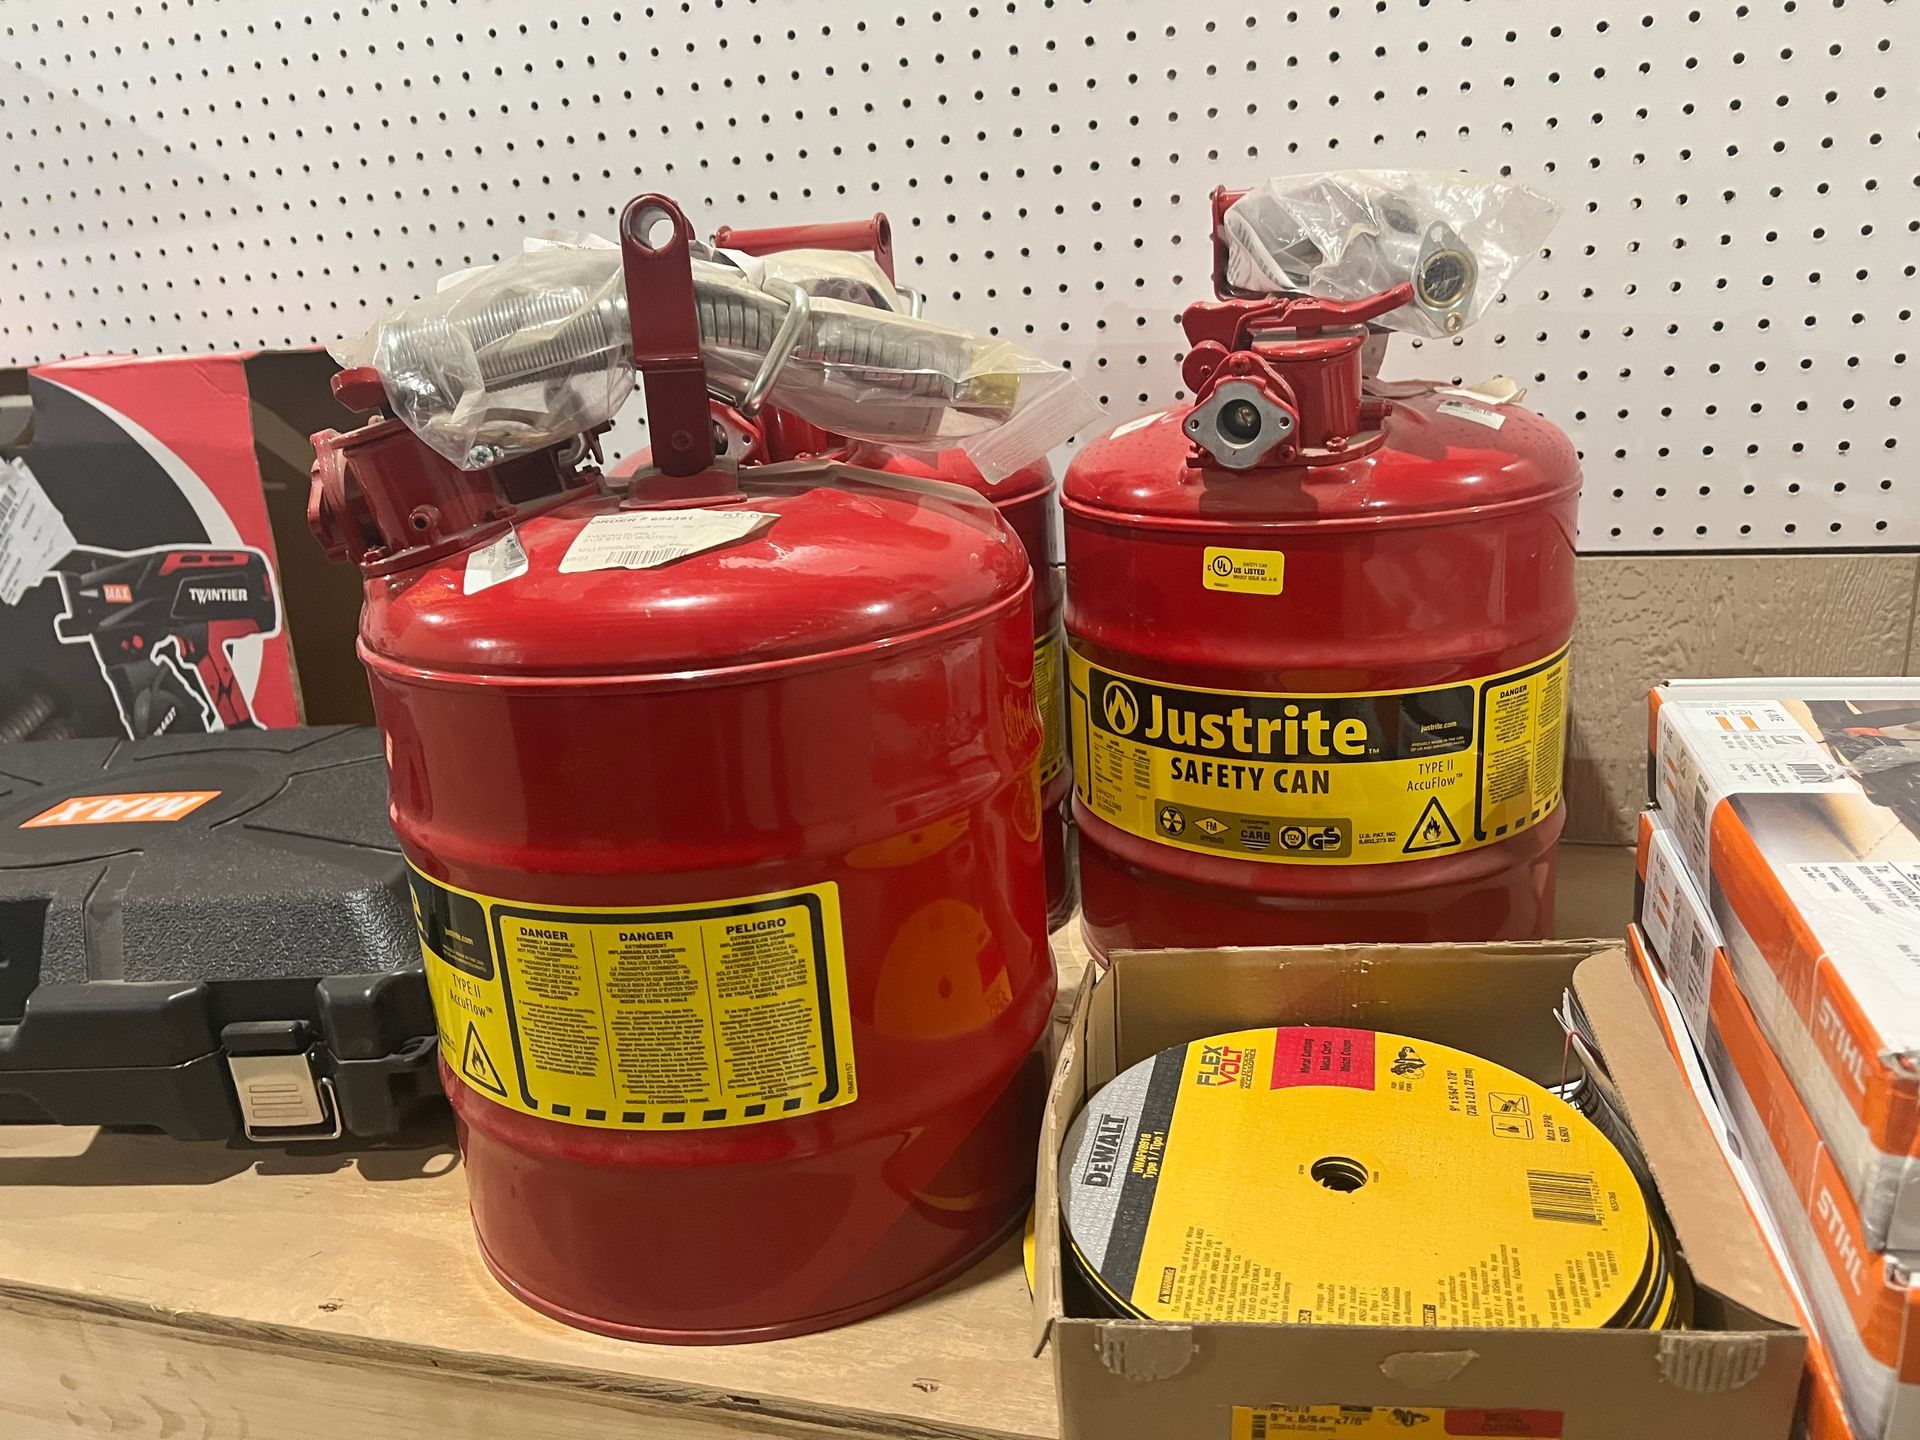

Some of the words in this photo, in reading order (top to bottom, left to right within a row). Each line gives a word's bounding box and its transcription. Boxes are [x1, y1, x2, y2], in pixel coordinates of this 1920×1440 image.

[1244, 568, 1265, 576] LISTED
[104, 585, 130, 601] MAX
[188, 587, 248, 605] TWINTIER
[1499, 684, 1528, 699] DANGER
[1420, 721, 1457, 733] justrite.com
[1171, 756, 1265, 792] SAFETY
[1273, 768, 1330, 795] CAN
[1418, 762, 1444, 776] TYPE
[1446, 759, 1455, 772] II
[35, 796, 204, 823] MAX
[1206, 821, 1218, 832] FM
[1240, 829, 1271, 841] CARB
[1308, 826, 1341, 851] GS
[520, 927, 569, 941] DANGER
[726, 918, 787, 935] PELIGRO
[619, 931, 674, 942] DANGER
[452, 974, 473, 996] TYPE
[1818, 996, 1866, 1094] STIHL
[1196, 1045, 1224, 1087] FLEX
[1216, 1046, 1243, 1087] VOLT
[1149, 1136, 1164, 1151] Tipo
[1142, 1161, 1158, 1179] Type
[1816, 1185, 1861, 1296] STIHL
